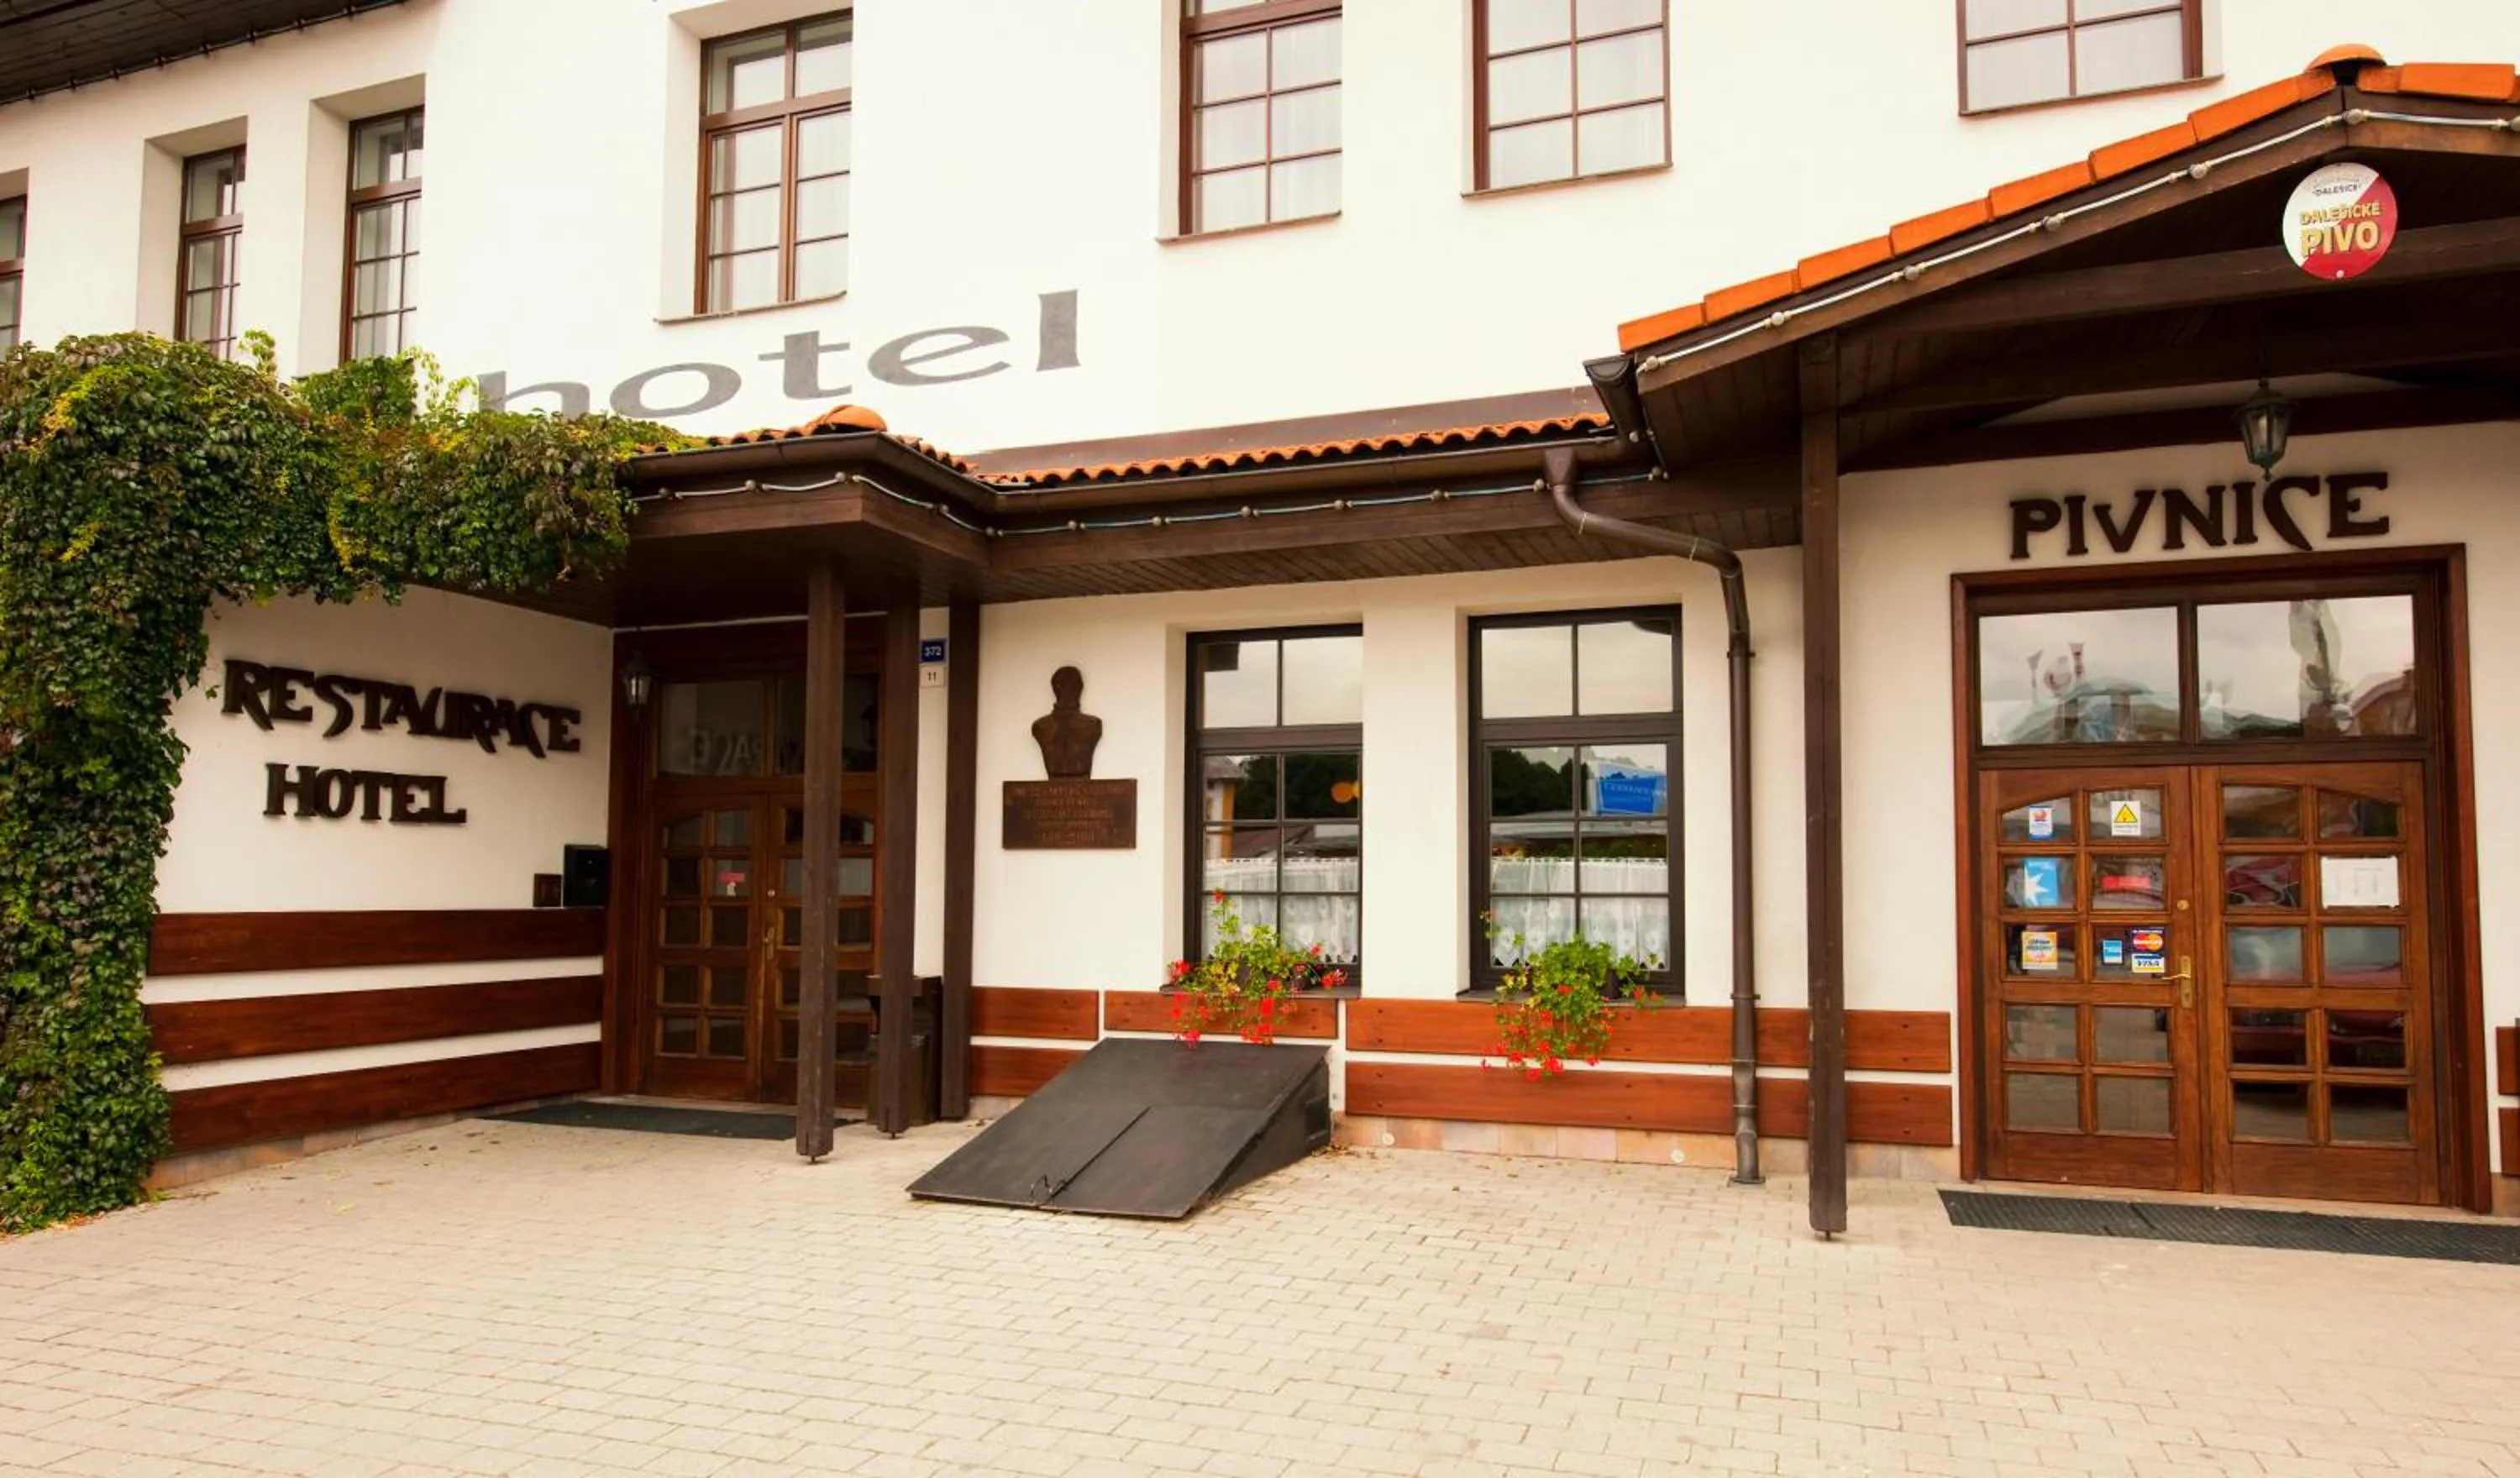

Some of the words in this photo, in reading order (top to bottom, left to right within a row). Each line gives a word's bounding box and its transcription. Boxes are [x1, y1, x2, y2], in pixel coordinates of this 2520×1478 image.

[2300, 221, 2379, 257] PIVO
[477, 289, 1081, 422] hotel
[2009, 472, 2390, 560] PIVNICE
[220, 658, 581, 759] RESTAURACE
[263, 763, 467, 825] HOTEL
